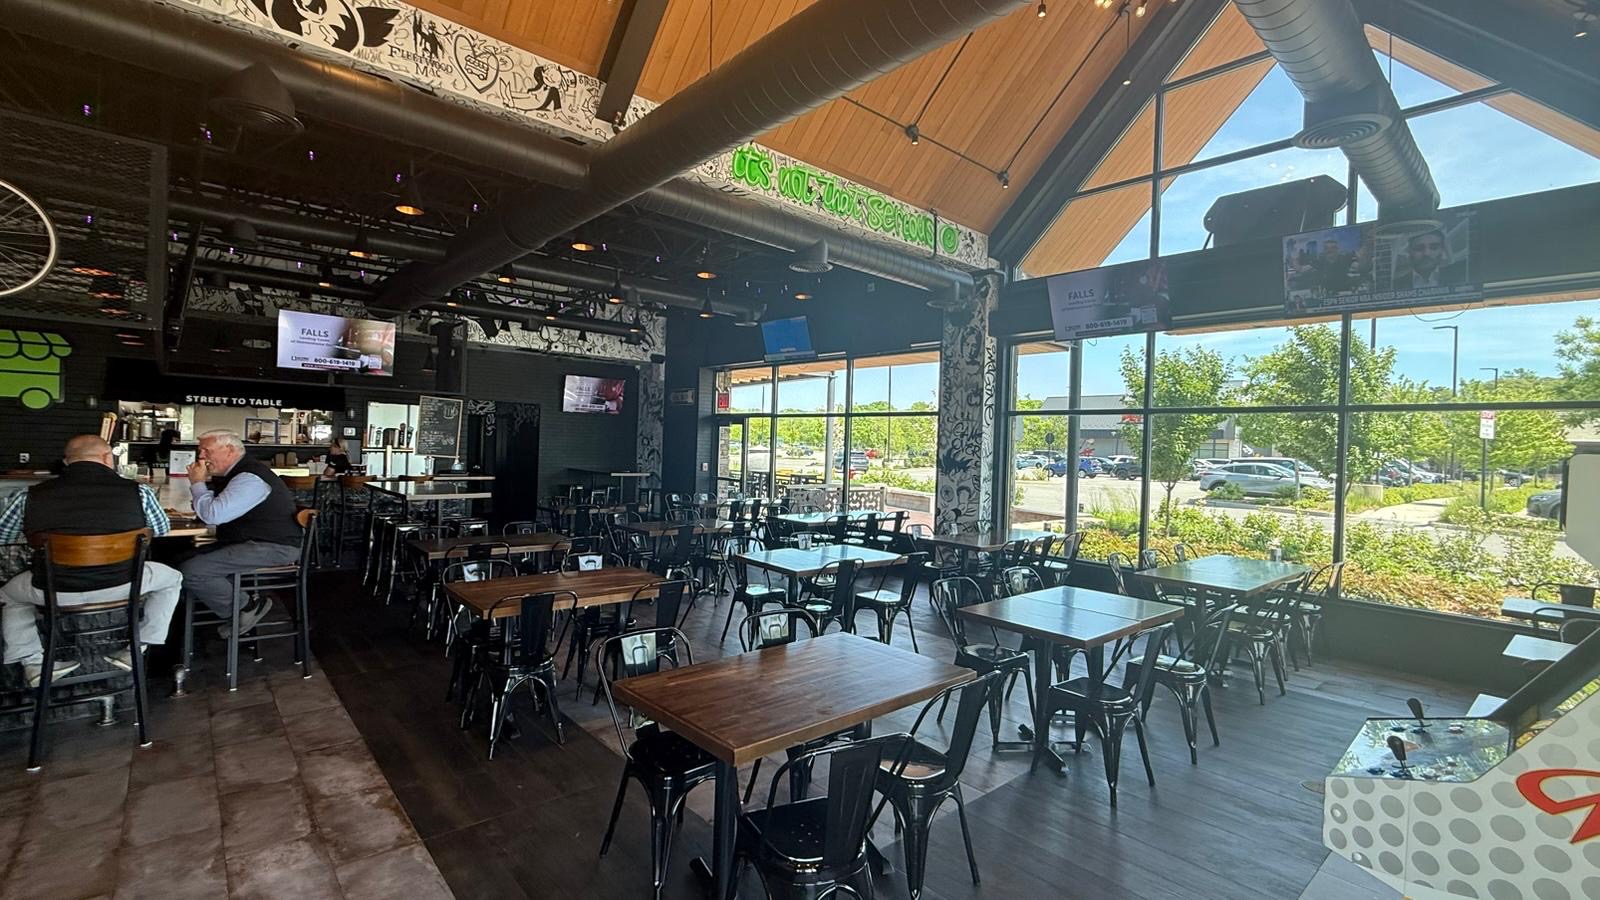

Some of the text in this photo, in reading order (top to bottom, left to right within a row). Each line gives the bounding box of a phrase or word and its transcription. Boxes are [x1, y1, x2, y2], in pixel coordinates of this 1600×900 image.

[778, 165, 821, 205] not
[1068, 288, 1095, 300] FALLS
[301, 328, 329, 338] FALLS
[185, 394, 283, 407] STREET TO TABLE
